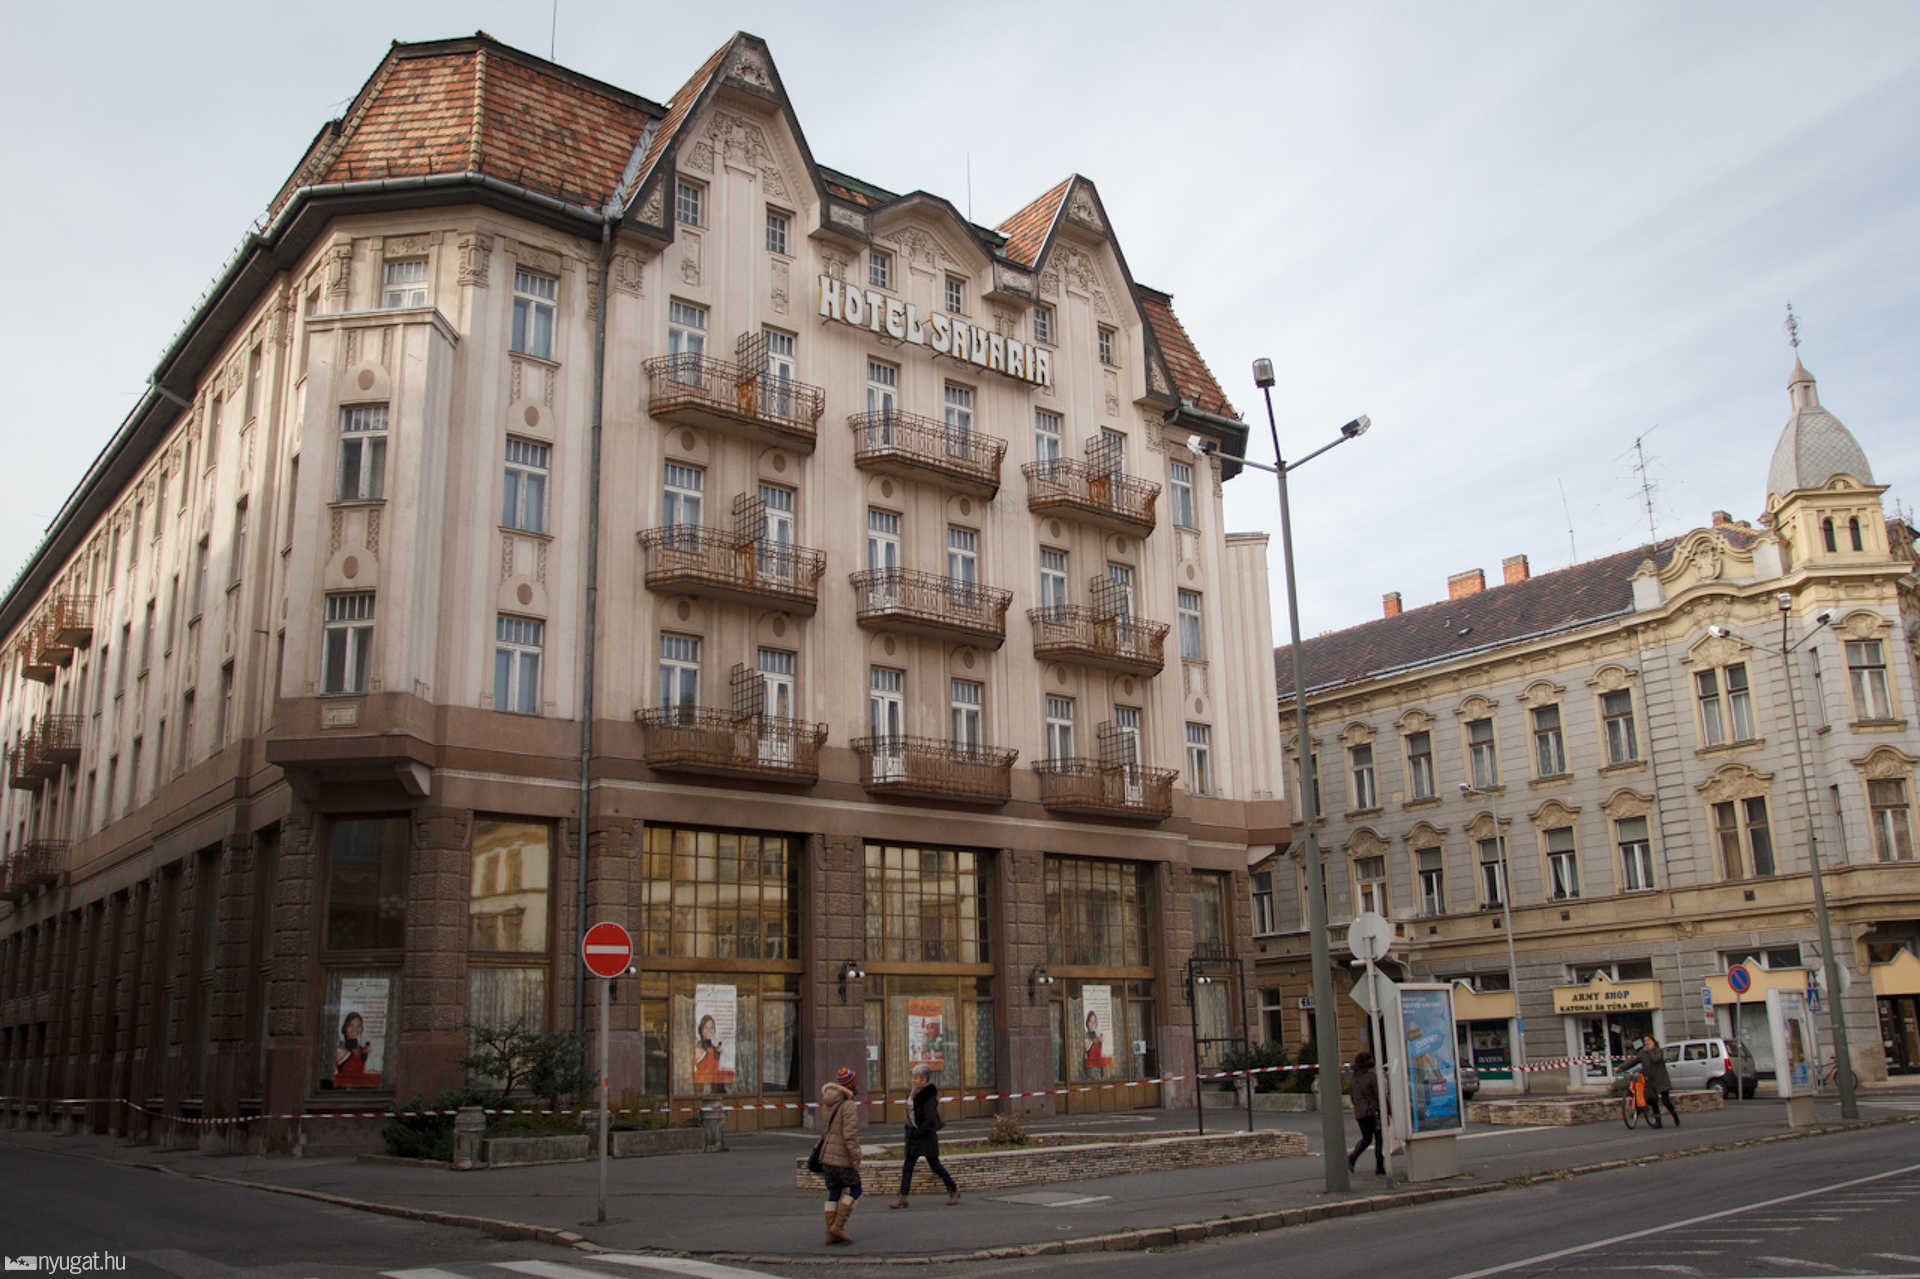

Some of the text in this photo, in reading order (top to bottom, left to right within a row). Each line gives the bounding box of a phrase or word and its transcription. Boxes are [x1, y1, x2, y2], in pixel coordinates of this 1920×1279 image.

[818, 274, 1052, 387] HOTEL SAVARIA
[1571, 990, 1630, 1002] ARMY SHOP
[1630, 1001, 1649, 1009] BOLT
